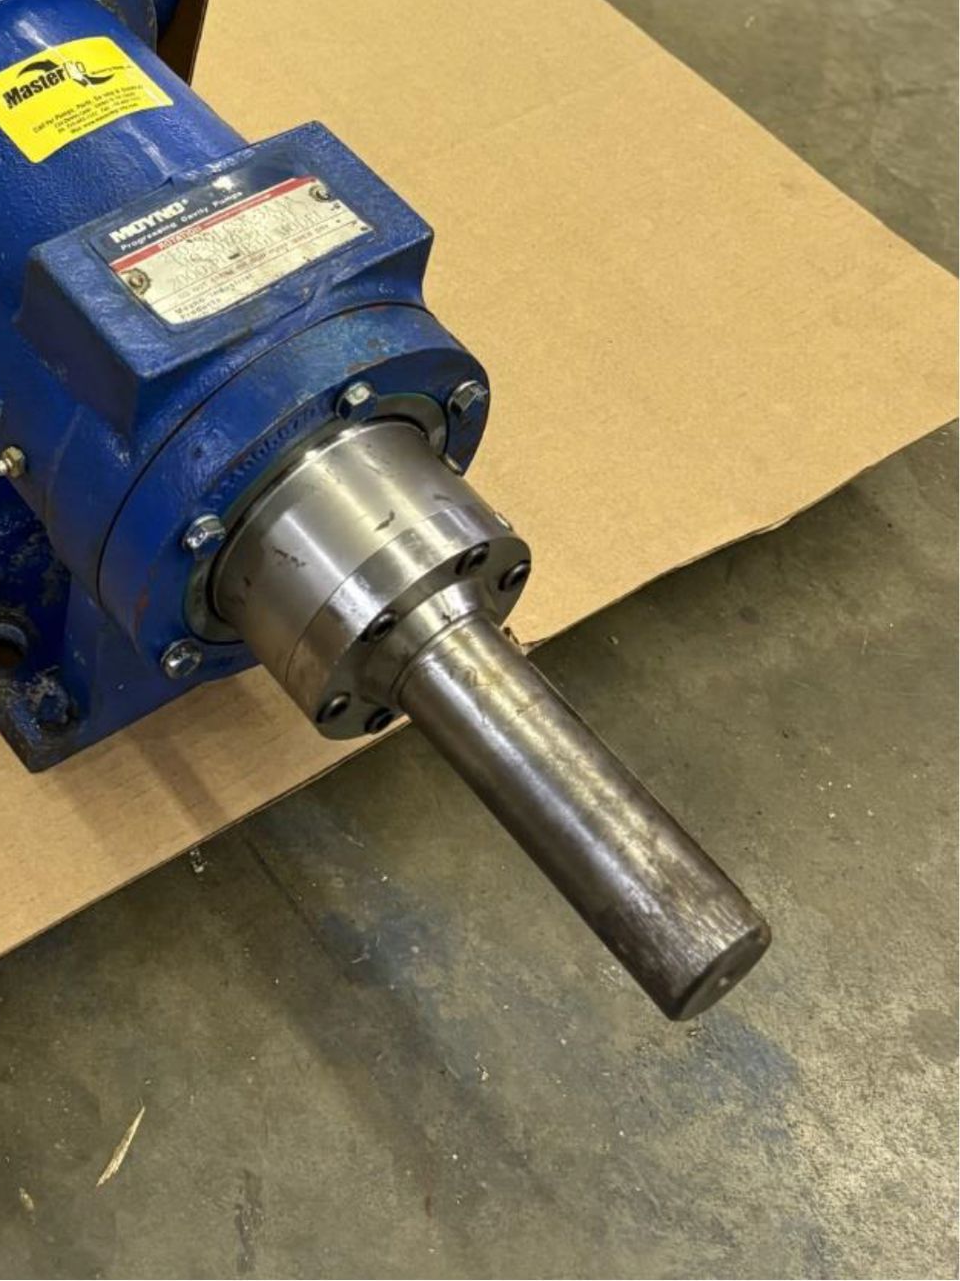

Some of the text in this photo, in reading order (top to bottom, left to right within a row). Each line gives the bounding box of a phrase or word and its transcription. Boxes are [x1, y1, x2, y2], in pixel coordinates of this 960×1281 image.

[120, 222, 178, 252] Progressing
[181, 207, 209, 222] Cavity
[212, 191, 243, 208] Pumps
